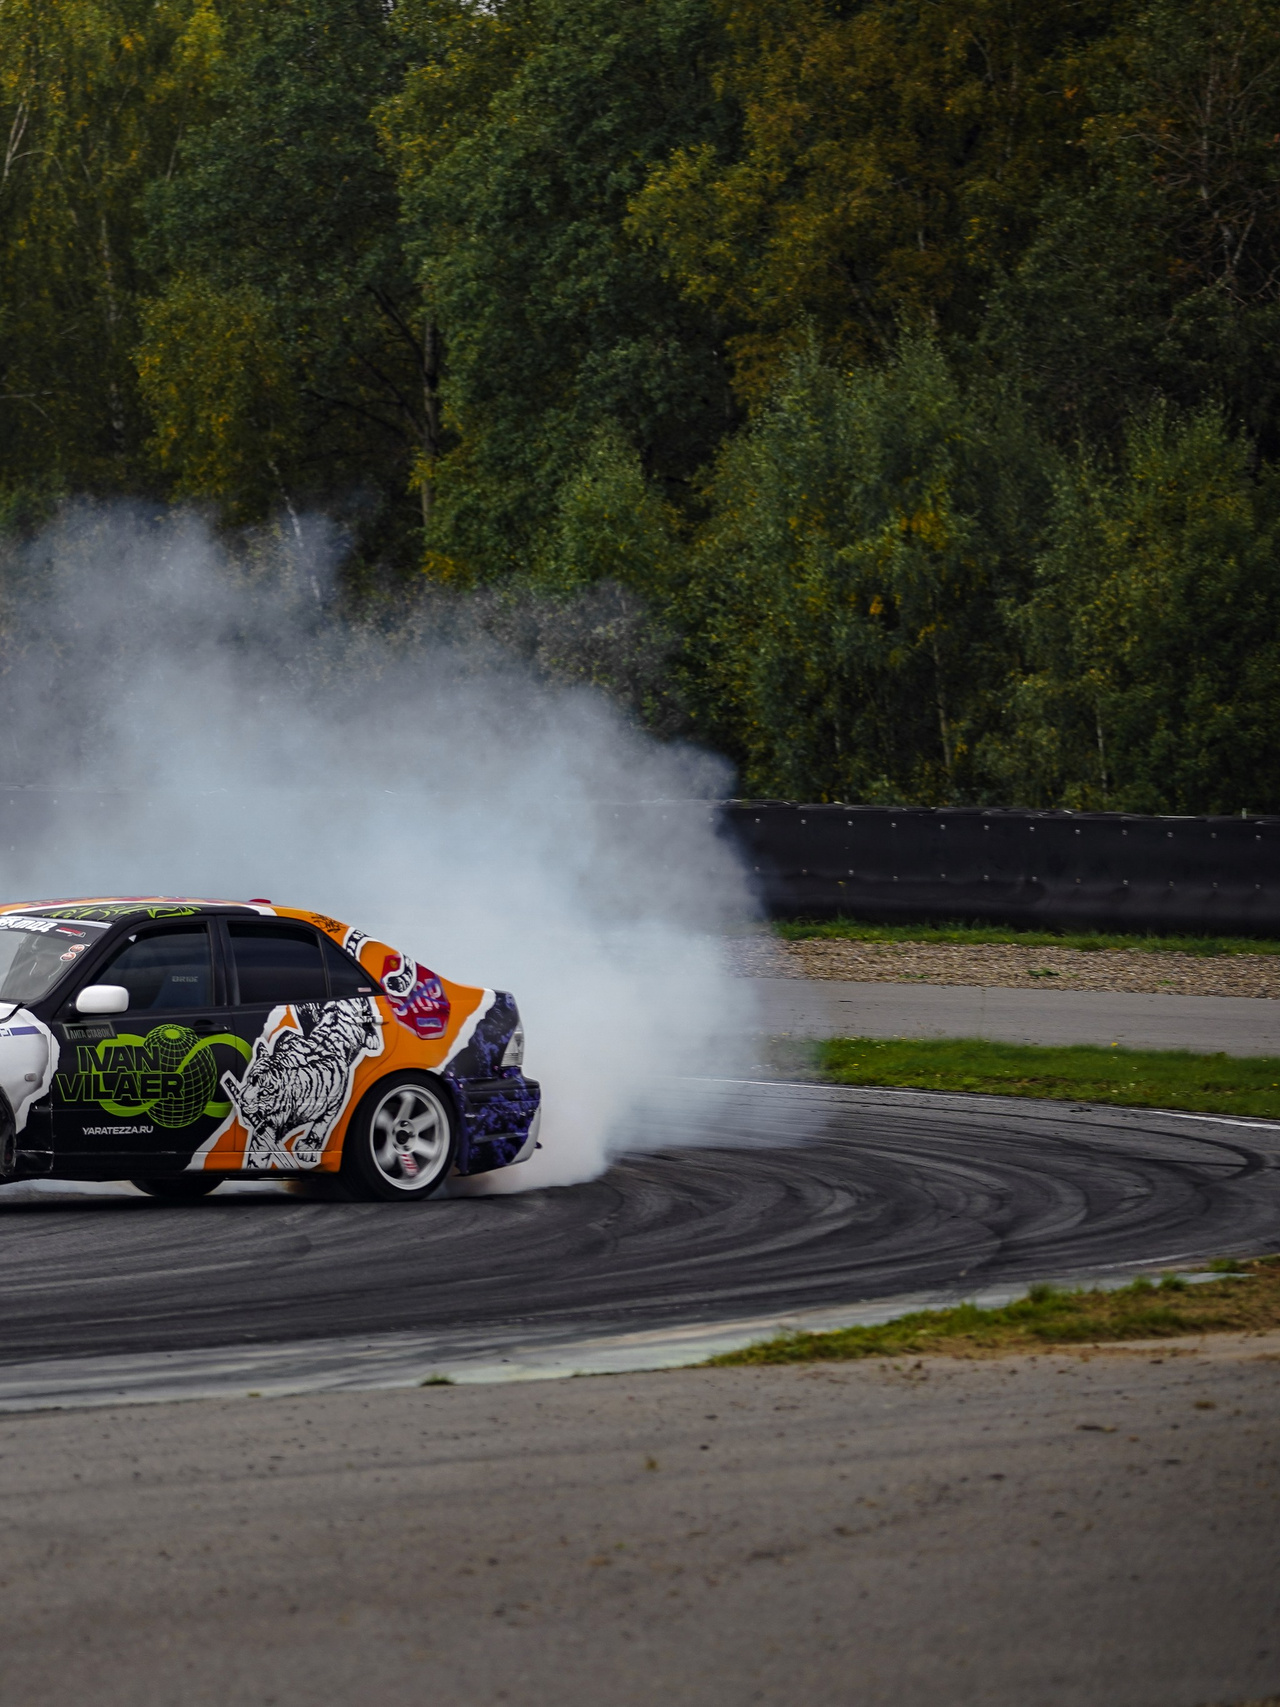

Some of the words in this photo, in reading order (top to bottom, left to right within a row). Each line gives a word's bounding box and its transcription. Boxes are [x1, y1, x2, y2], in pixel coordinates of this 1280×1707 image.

[76, 1045, 161, 1073] IVAN
[55, 1072, 184, 1101] VILAER
[82, 1125, 154, 1136] YARATEZZA.RU
